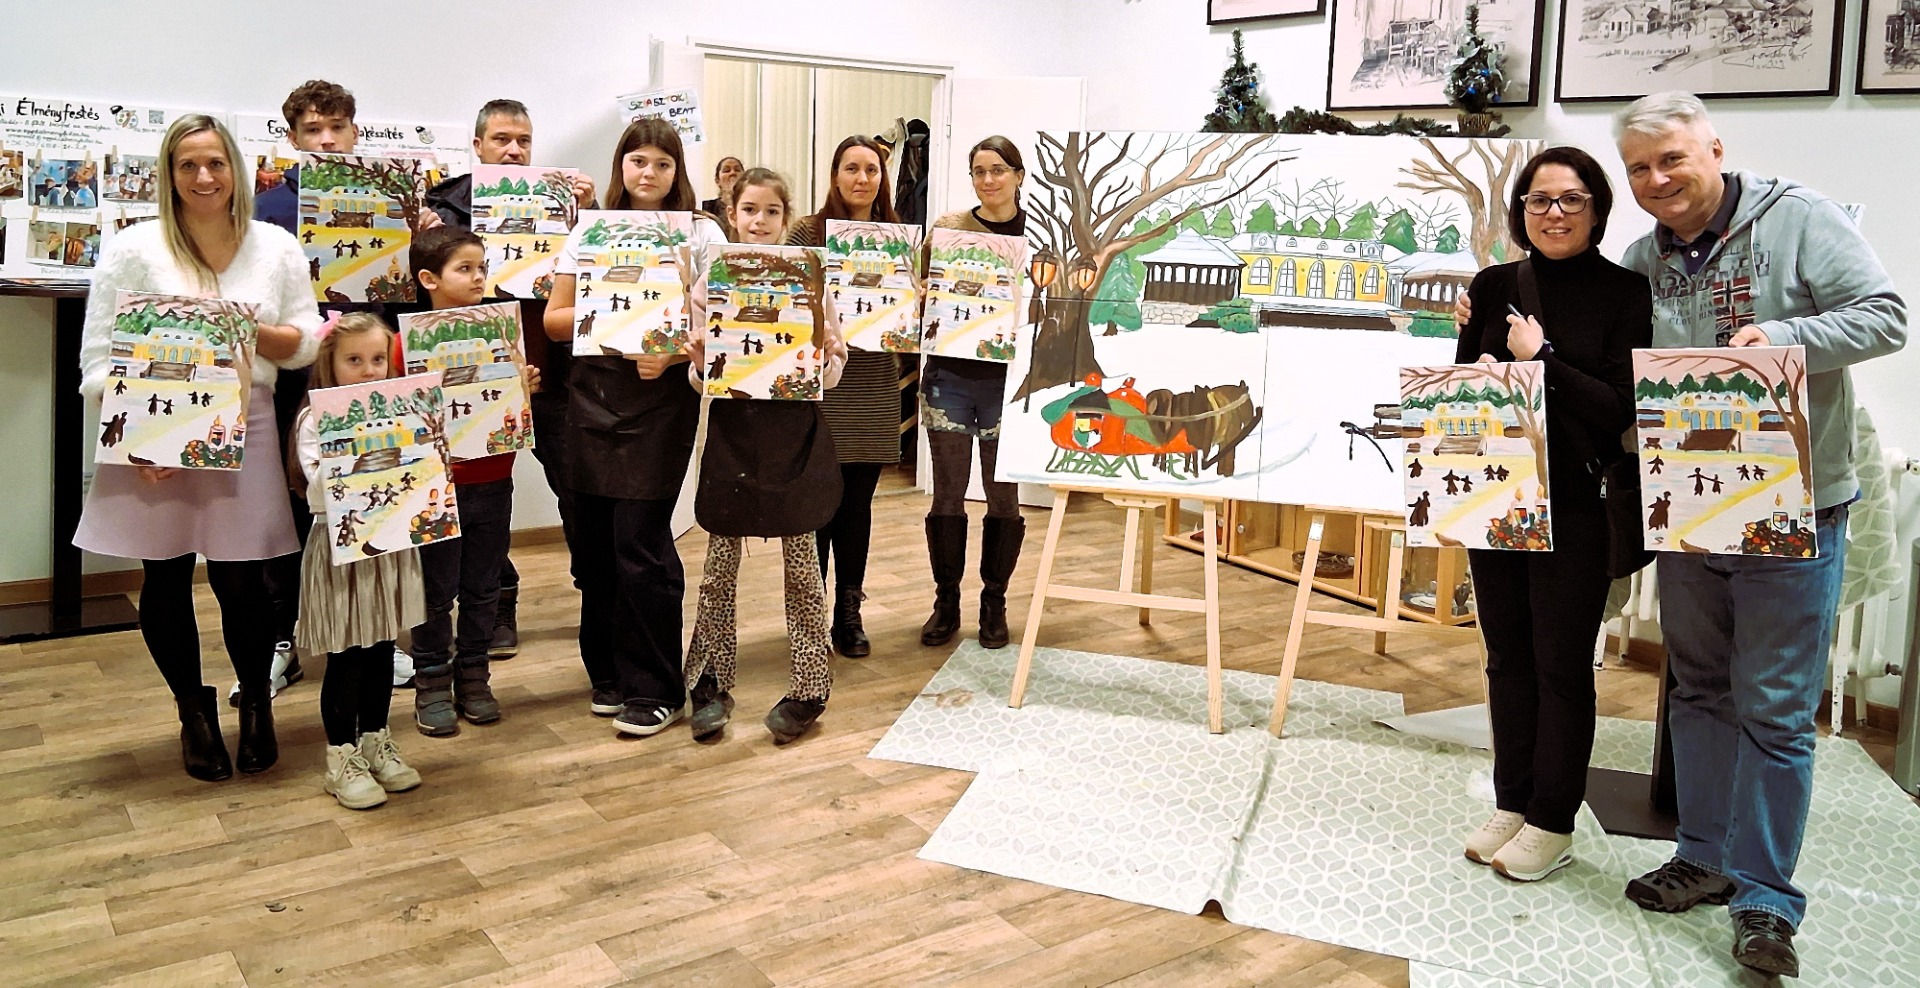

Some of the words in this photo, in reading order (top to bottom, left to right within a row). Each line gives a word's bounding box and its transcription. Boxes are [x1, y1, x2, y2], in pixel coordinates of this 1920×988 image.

[16, 97, 100, 123] Élményfestés
[266, 119, 289, 139] Egy
[358, 126, 405, 141] akészítés
